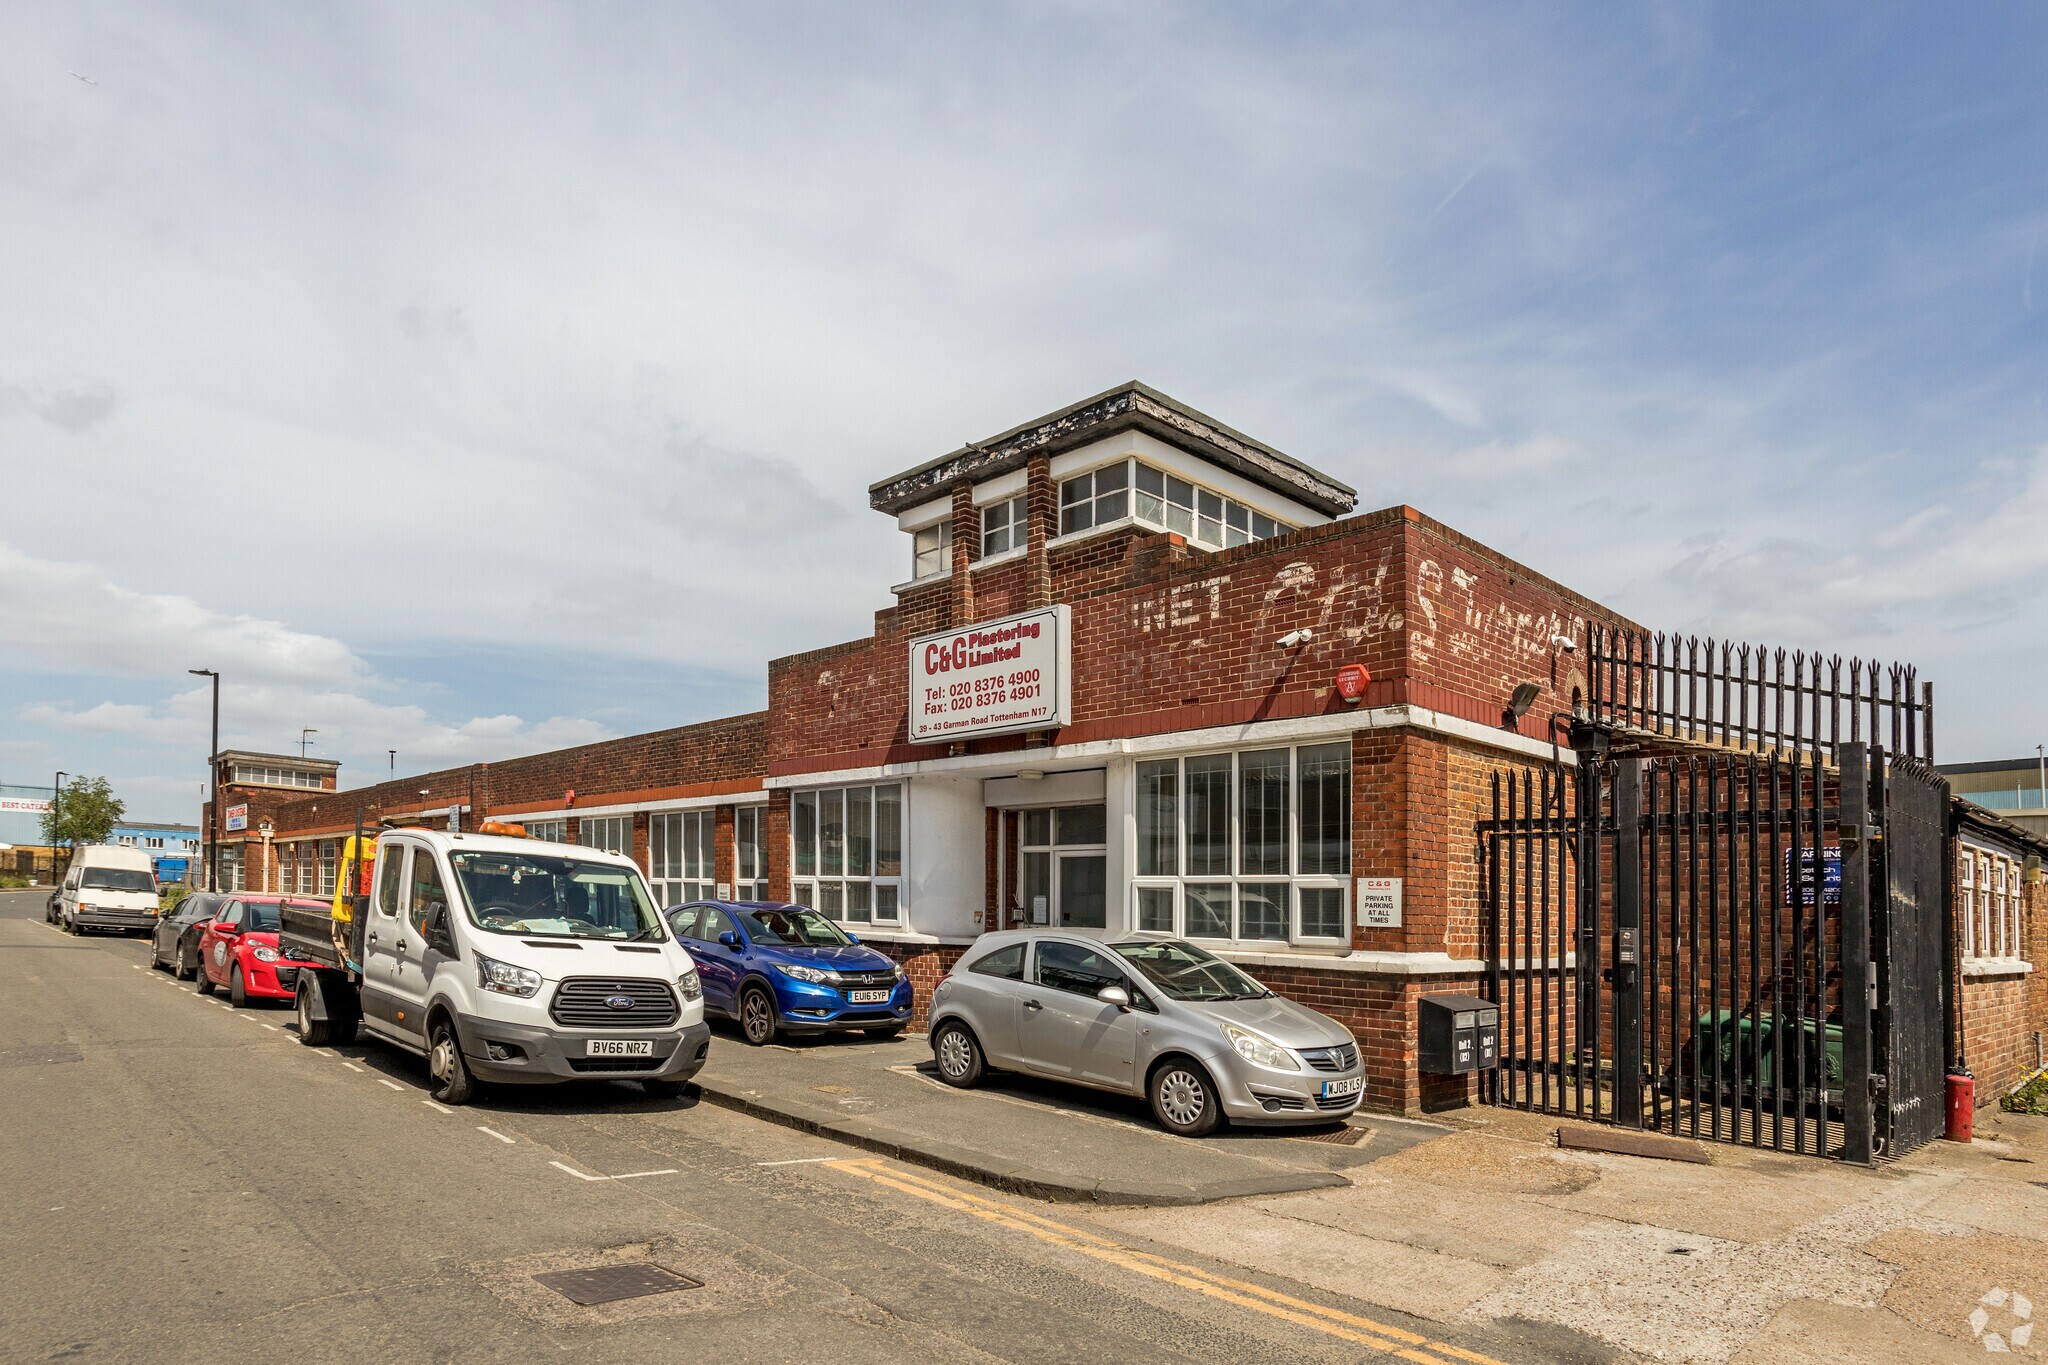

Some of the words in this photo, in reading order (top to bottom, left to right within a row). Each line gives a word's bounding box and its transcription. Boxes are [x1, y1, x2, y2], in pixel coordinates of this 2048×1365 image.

[925, 637, 967, 675] C&G
[968, 622, 1040, 649] Plastering
[969, 642, 1021, 668] Limited
[925, 687, 945, 701] Tel:
[950, 682, 971, 697] 020
[974, 675, 1004, 693] 8376
[1008, 668, 1040, 686] 4900
[924, 703, 947, 715] Fax:
[951, 696, 972, 711] 020
[976, 690, 1006, 708] 8376
[1010, 684, 1041, 701] 4901
[919, 724, 928, 733] 39
[933, 722, 942, 731] 43
[943, 719, 969, 730] Garman
[971, 715, 988, 726] Road
[990, 711, 1029, 723] Tottenham
[1031, 706, 1047, 717] N17
[1, 801, 19, 809] BEST
[613, 998, 630, 1006] Ford
[872, 991, 887, 1000] SYP
[593, 1042, 623, 1054] BV66
[626, 1042, 648, 1054] NRZ
[1349, 1078, 1360, 1092] YLS
